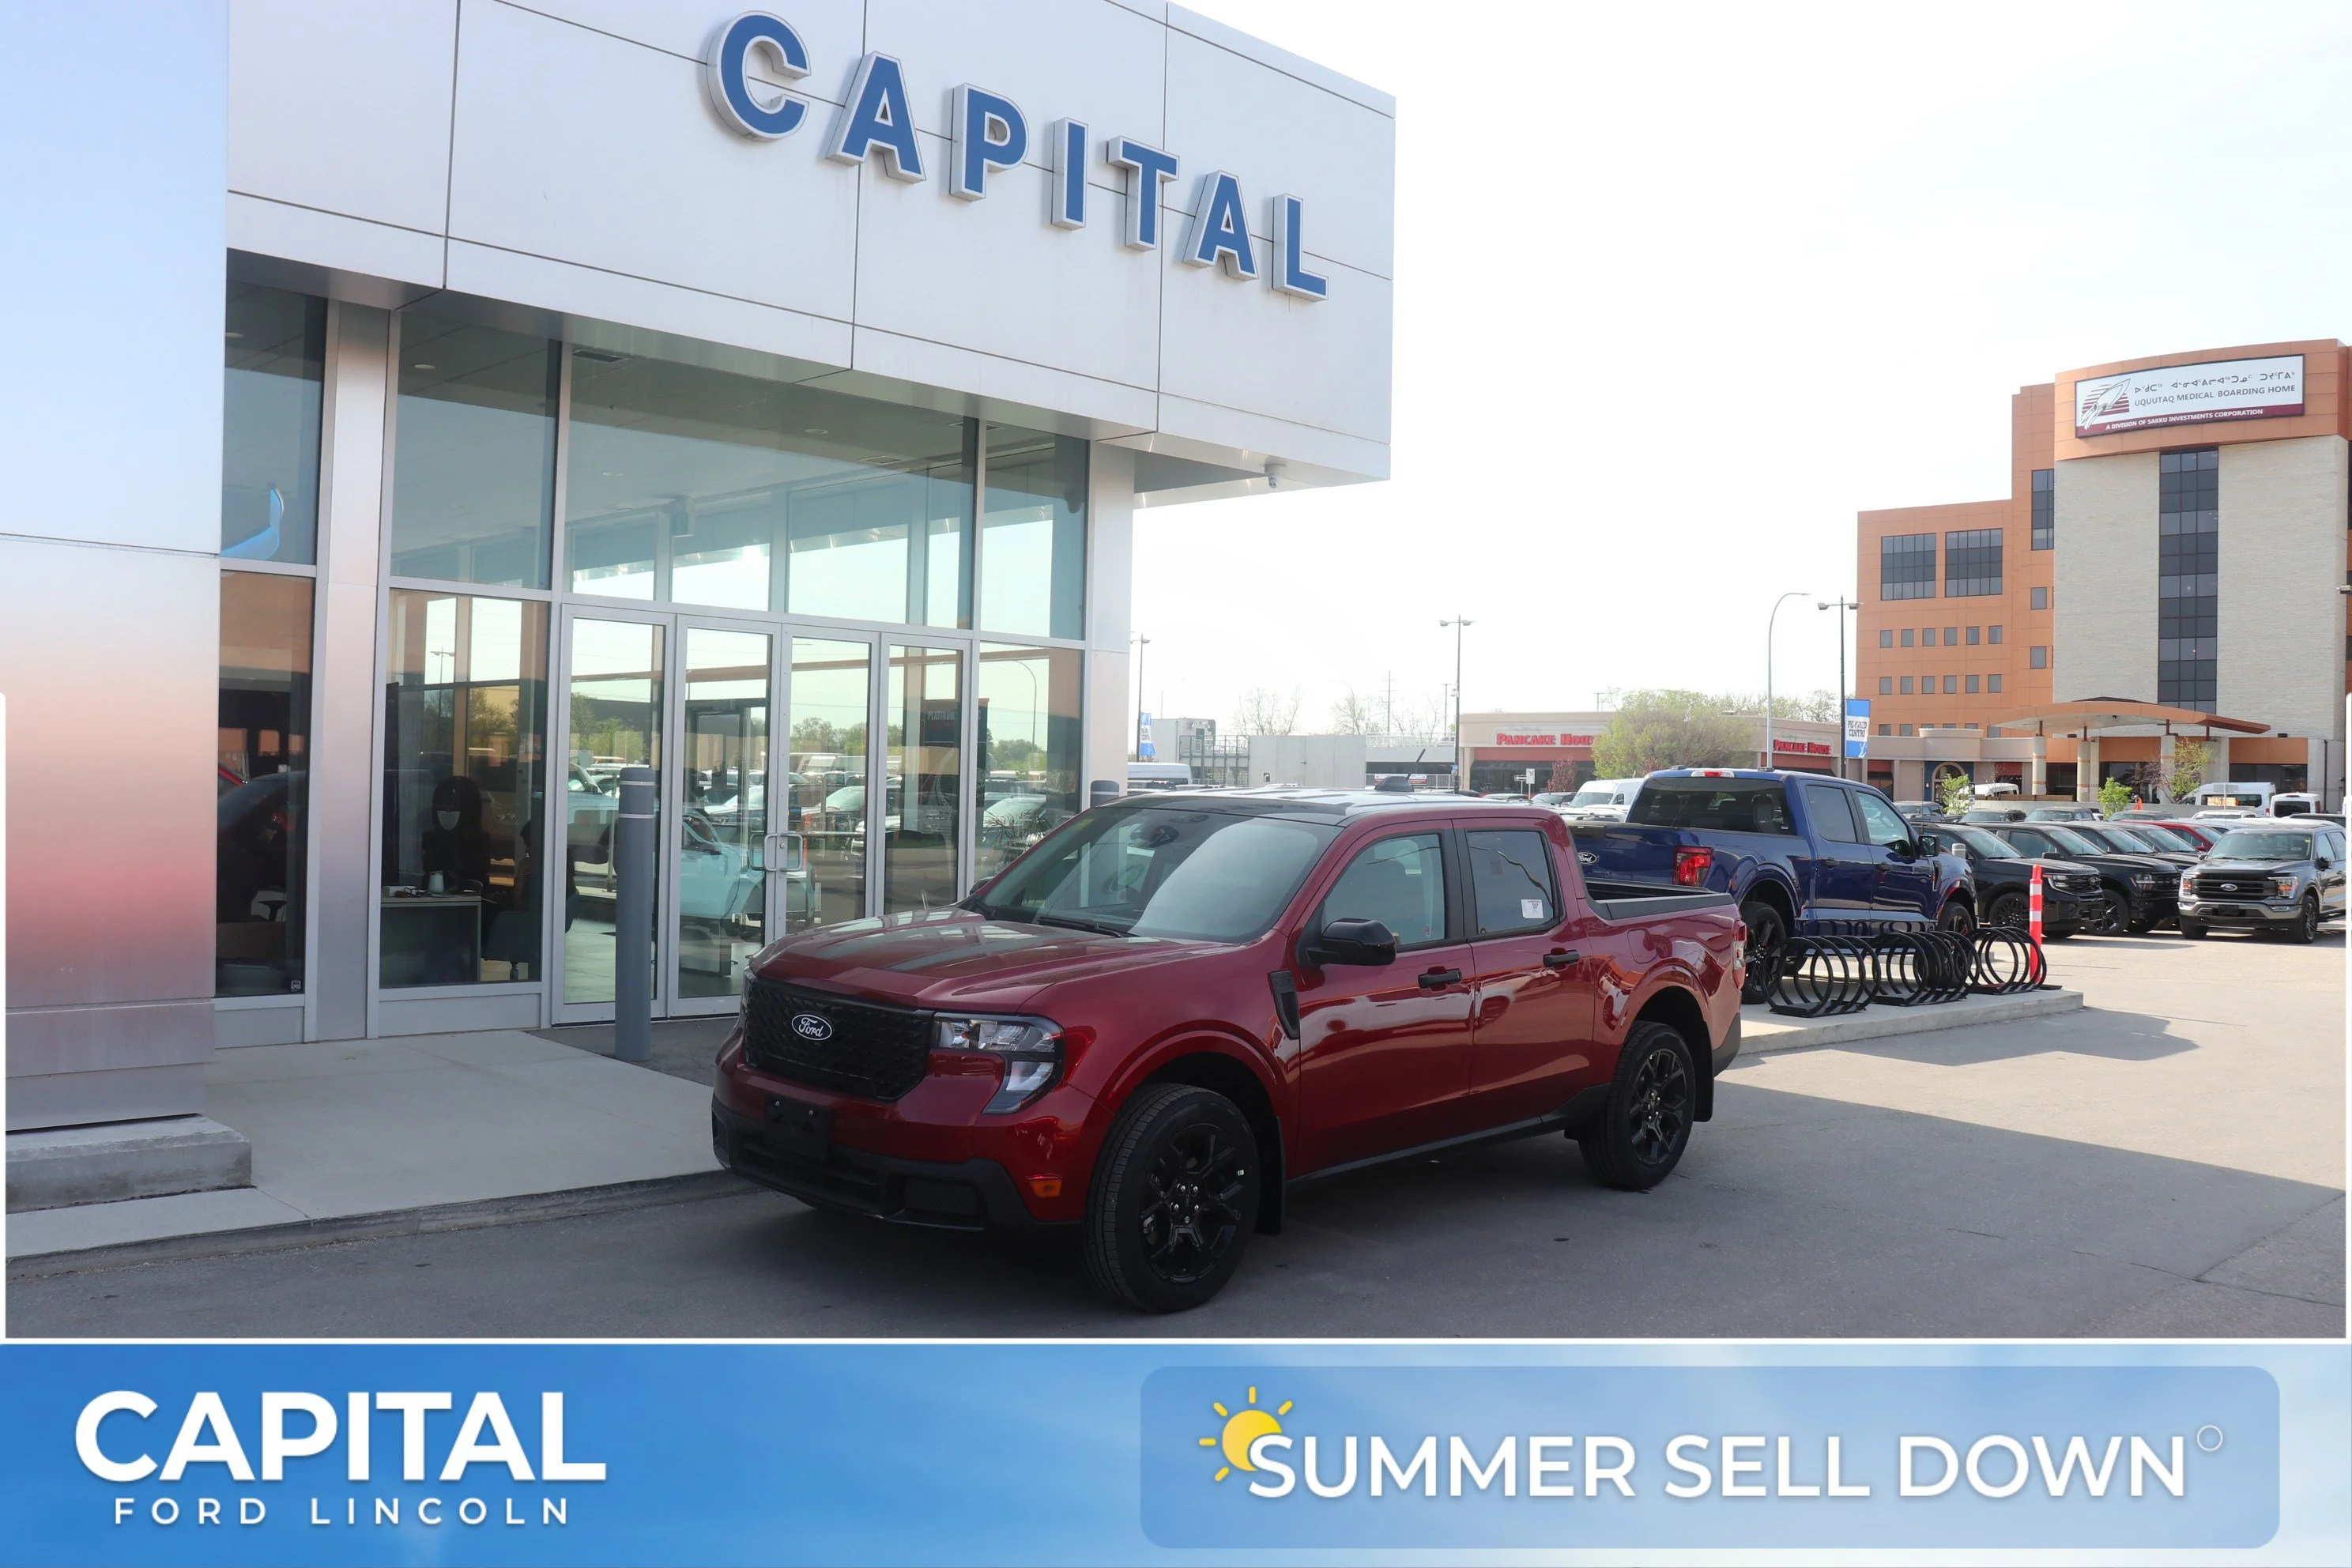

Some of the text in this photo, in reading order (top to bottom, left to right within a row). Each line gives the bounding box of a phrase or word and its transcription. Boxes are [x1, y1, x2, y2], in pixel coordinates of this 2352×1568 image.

[707, 10, 1329, 302] CAPITAL
[2135, 385, 2296, 406] UQUUTAQ MEDICAL BOARDING HOME
[2111, 420, 2137, 429] DIVISION
[2169, 413, 2213, 422] INVESTMENTS
[2214, 409, 2263, 418] CORPORATION
[1496, 733, 1555, 745] PANCAKE
[1773, 739, 1831, 755] PANCAKE HOUSE
[797, 1016, 825, 1038] Ford
